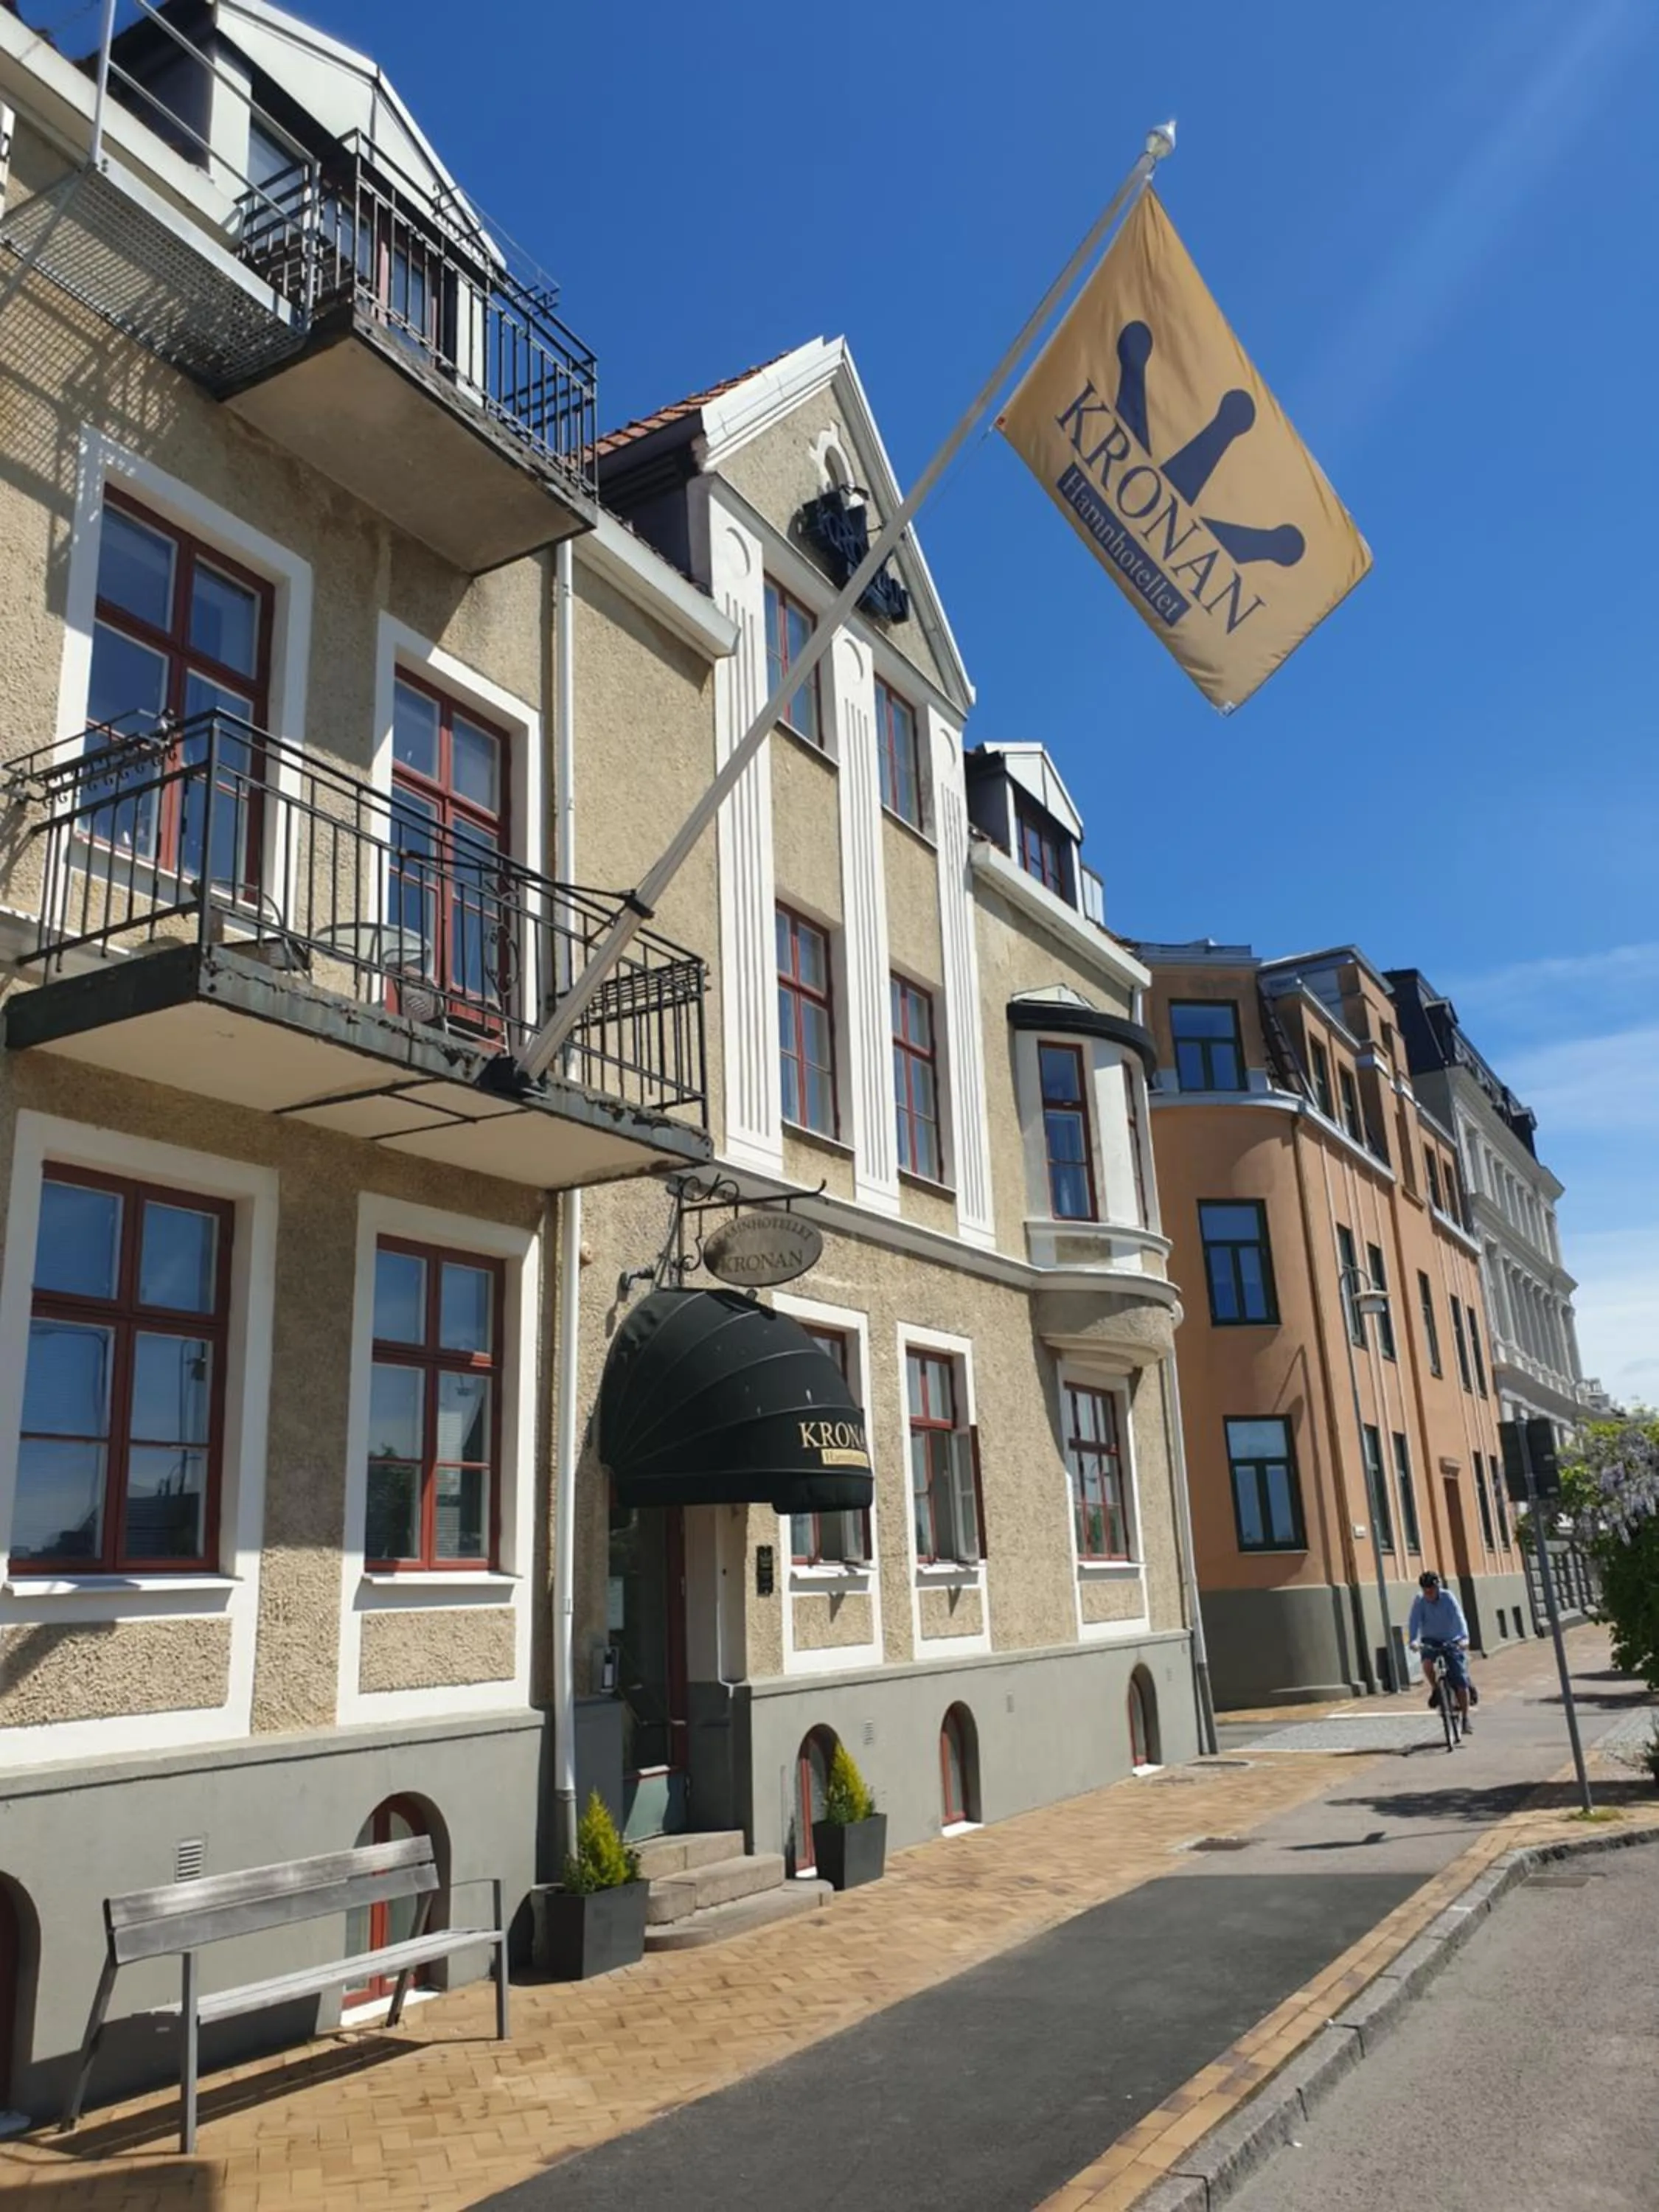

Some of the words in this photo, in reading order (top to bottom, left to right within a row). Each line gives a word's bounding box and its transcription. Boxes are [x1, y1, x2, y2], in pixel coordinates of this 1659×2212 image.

[1055, 378, 1266, 635] KRONAN
[1062, 472, 1180, 619] Hamnhotellet
[720, 1249, 803, 1274] KRONAN
